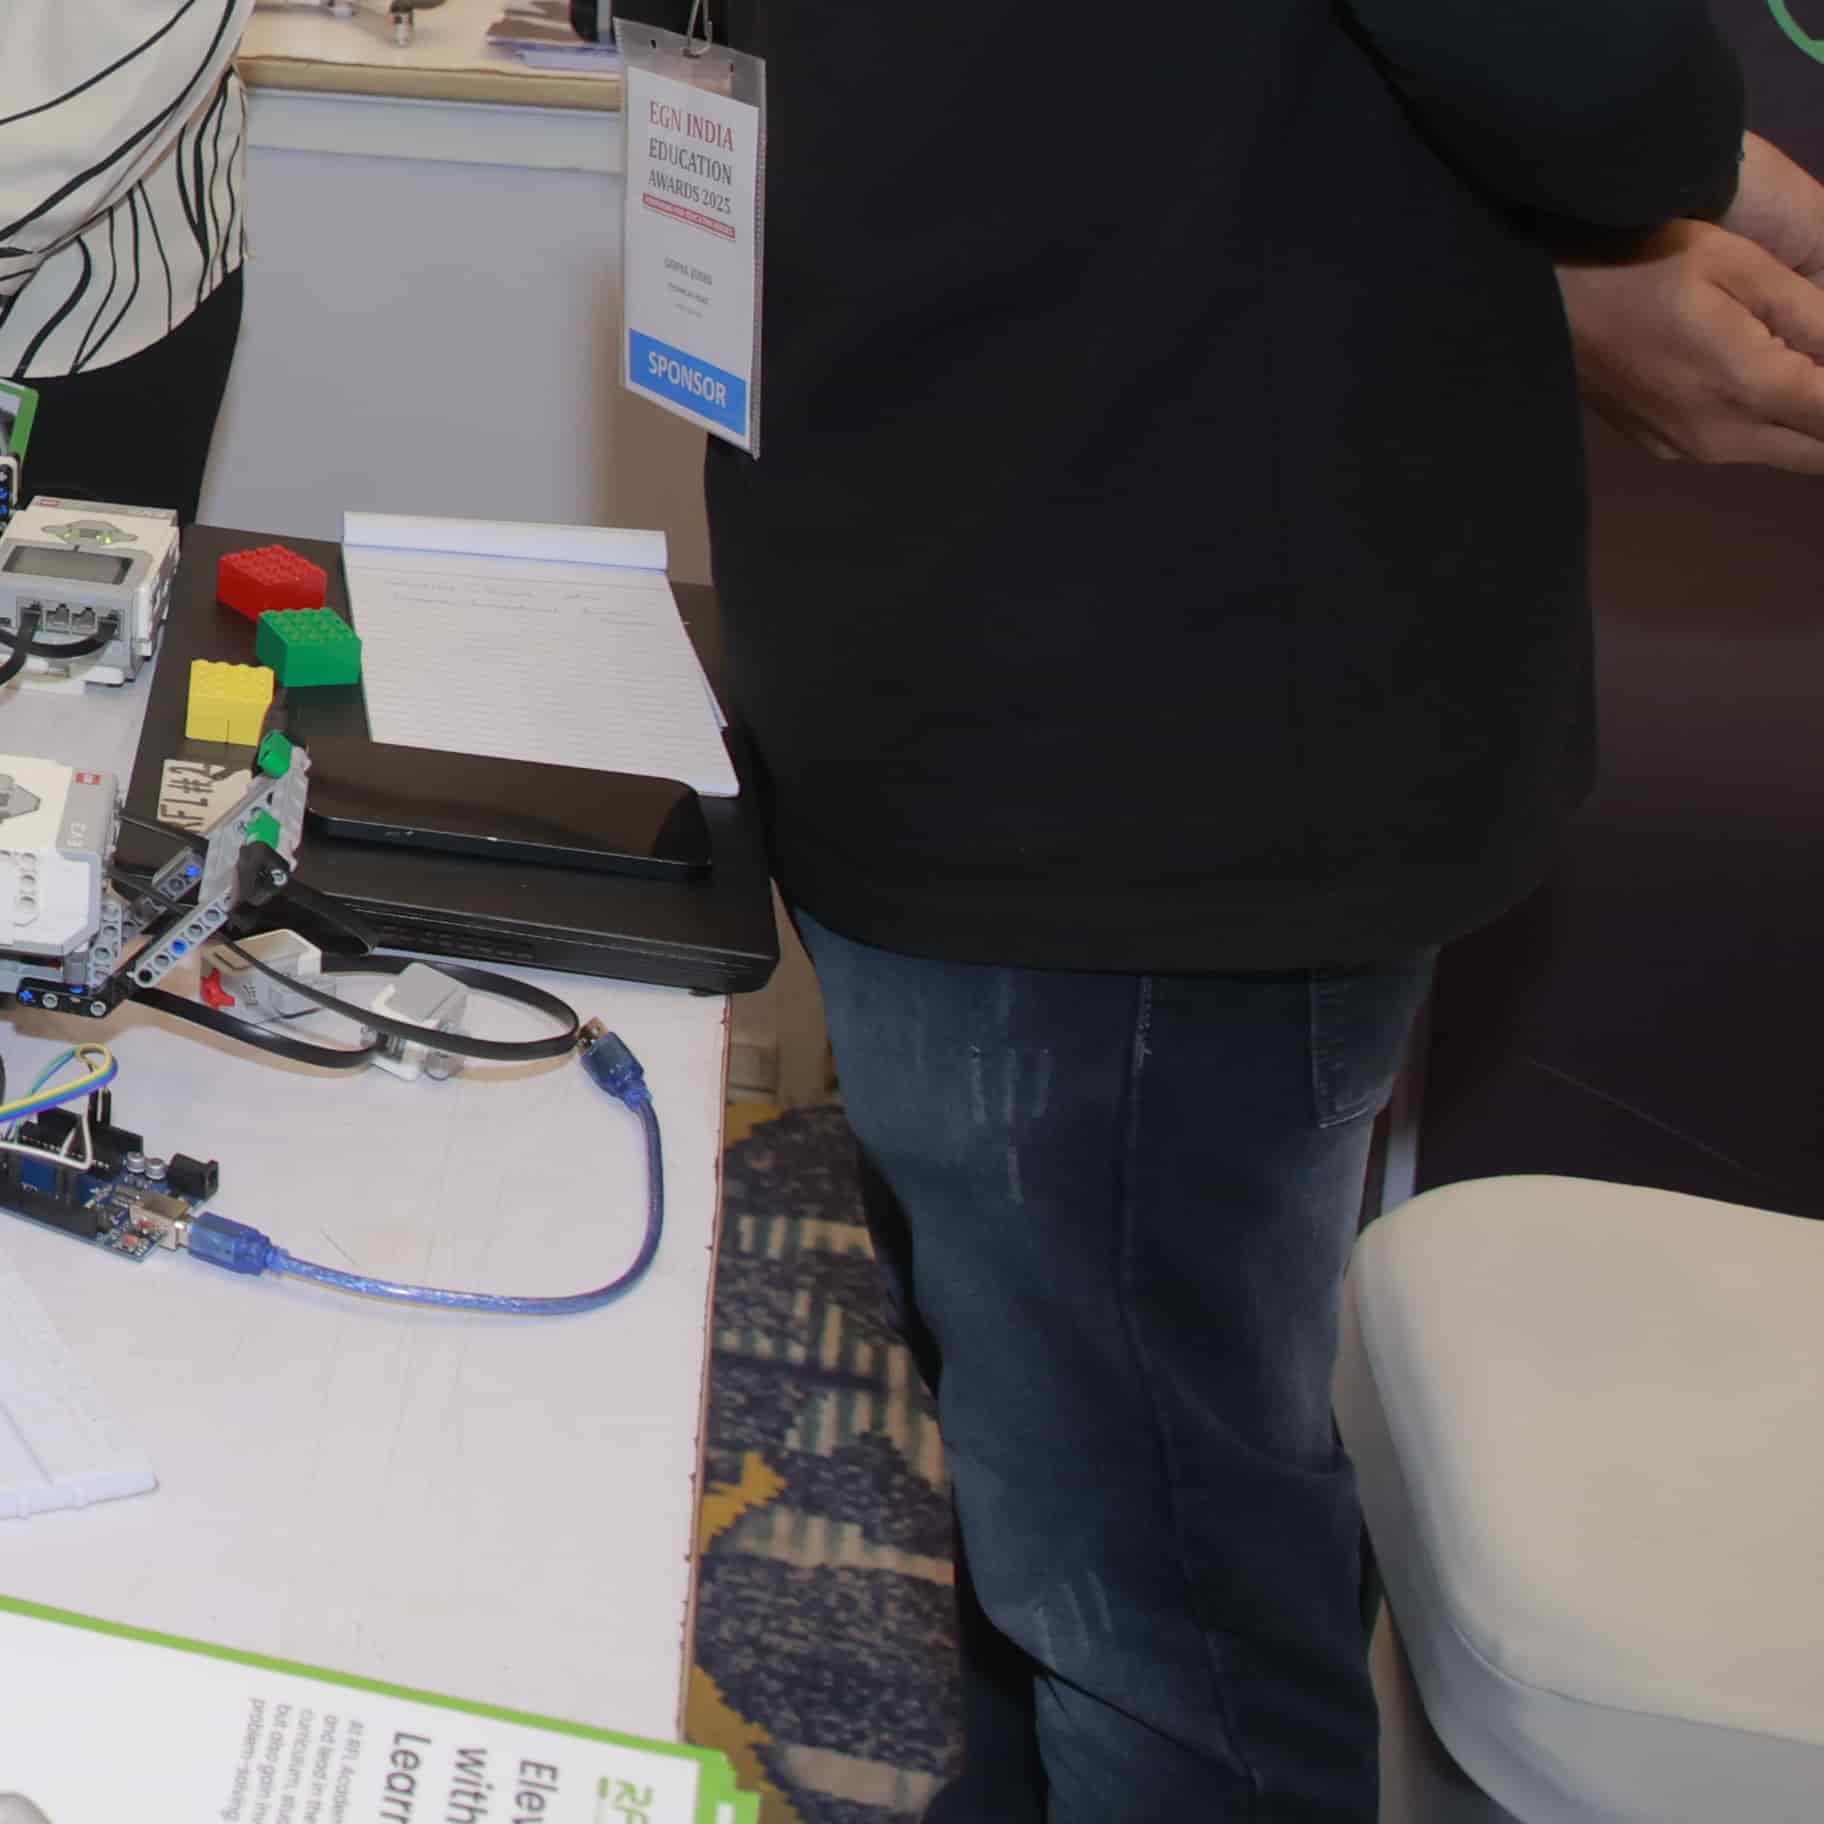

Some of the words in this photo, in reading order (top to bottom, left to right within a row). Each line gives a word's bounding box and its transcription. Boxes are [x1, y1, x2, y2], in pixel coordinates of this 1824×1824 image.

[649, 99, 682, 136] EGN
[685, 112, 735, 152] INDIA
[648, 137, 734, 185] EDUCATION
[648, 169, 701, 204] AWARDS
[702, 189, 732, 215] 2025
[647, 349, 728, 410] SPONSOR
